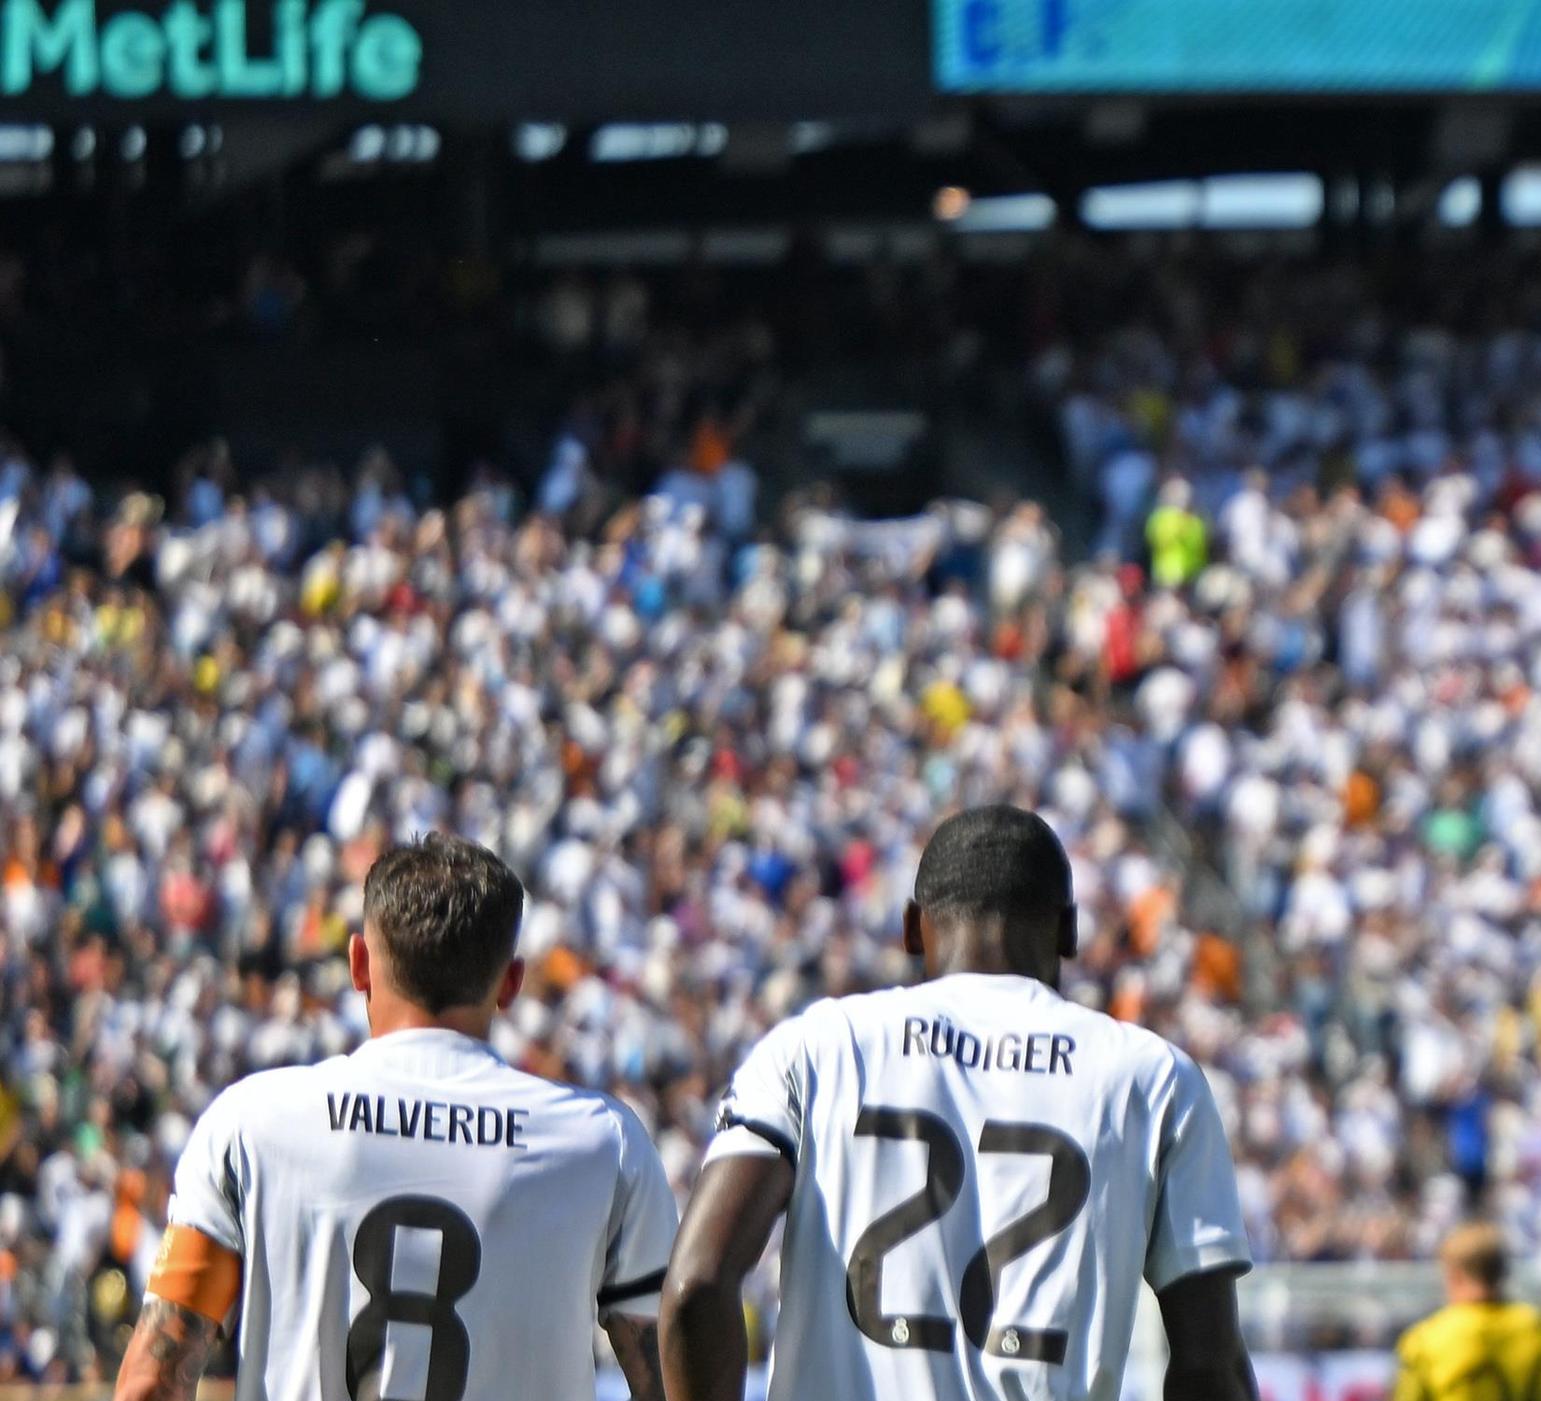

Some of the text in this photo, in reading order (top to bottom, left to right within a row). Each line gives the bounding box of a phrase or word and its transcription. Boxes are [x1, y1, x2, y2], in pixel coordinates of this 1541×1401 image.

[2, 0, 422, 101] MetLife
[902, 1013, 1077, 1075] RÜDIGER
[327, 1091, 530, 1149] VALVERDE
[846, 1103, 1091, 1366] 22
